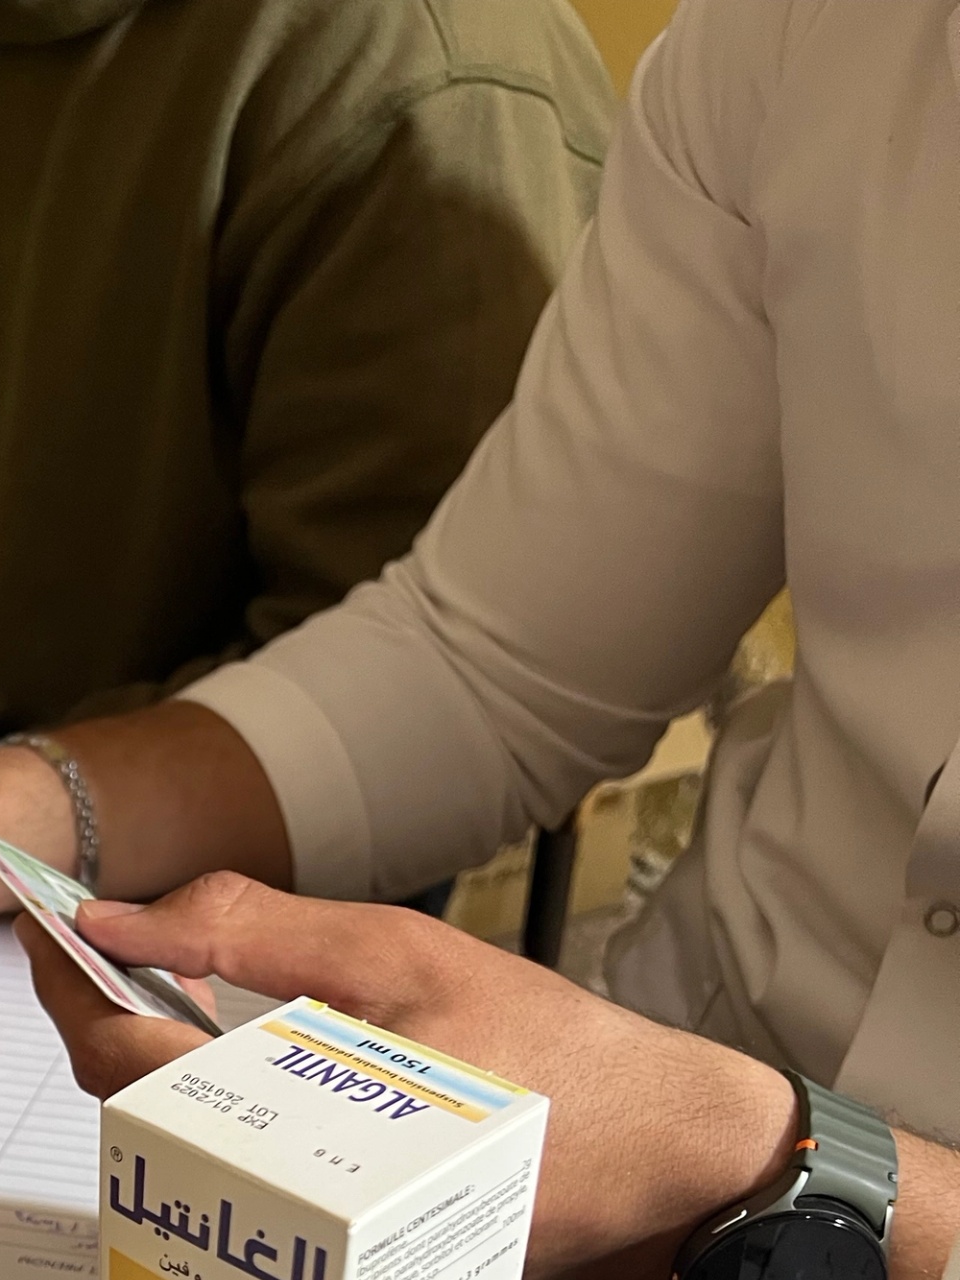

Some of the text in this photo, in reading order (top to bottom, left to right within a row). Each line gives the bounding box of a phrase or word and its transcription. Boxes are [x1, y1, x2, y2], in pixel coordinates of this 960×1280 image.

[352, 1060, 397, 1081] buvable
[356, 1039, 432, 1075] 150 ml
[181, 1073, 279, 1122] LOT 2601500
[273, 1044, 431, 1121] ALGANTIL
[397, 1077, 465, 1108] Suspension
[170, 1082, 269, 1130] EXP 01/2029
[358, 1227, 405, 1264] FORMULE
[474, 1238, 519, 1276] grammes
